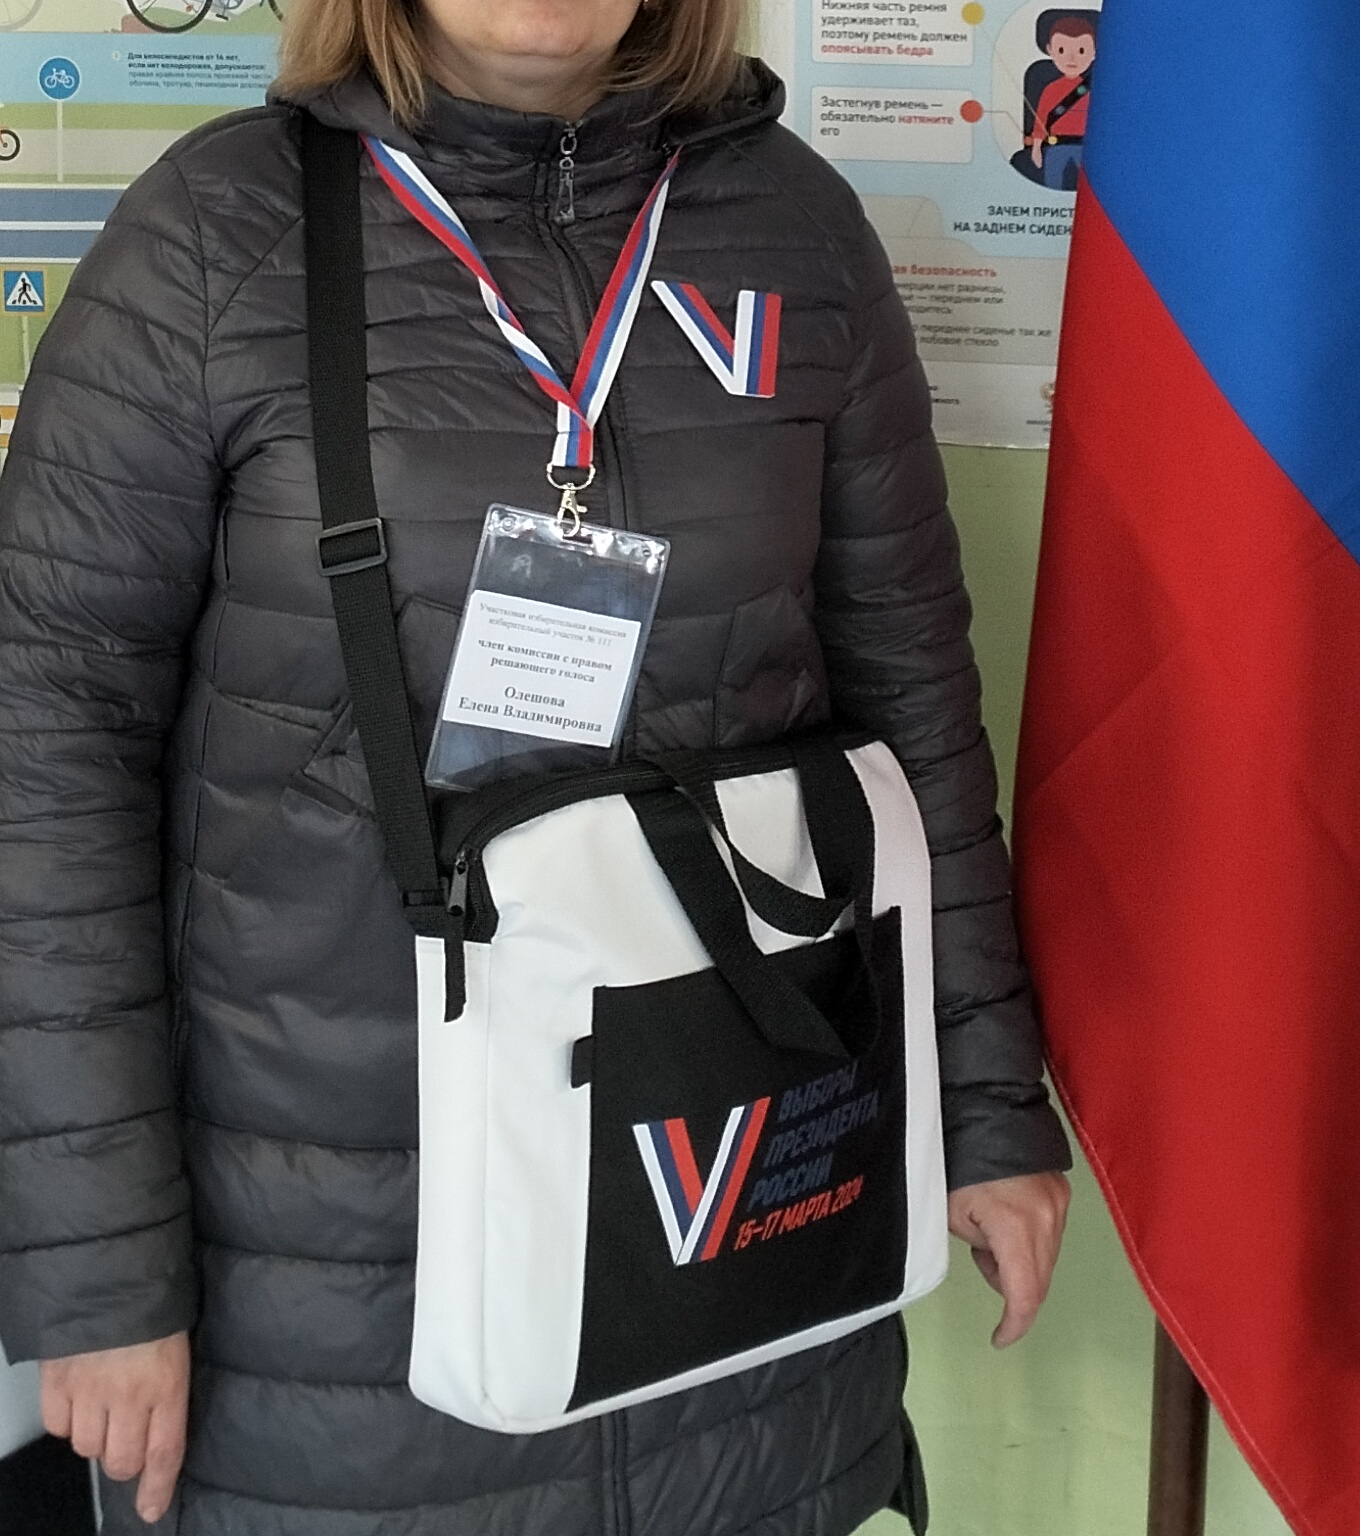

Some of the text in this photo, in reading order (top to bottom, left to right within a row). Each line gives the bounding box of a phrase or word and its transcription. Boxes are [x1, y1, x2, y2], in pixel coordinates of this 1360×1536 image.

[821, 0, 947, 13] Нижняя часть ремня
[821, 15, 920, 28] удерживает таз,
[821, 30, 968, 43] поэтому ремень должен
[821, 44, 934, 58] опоясывать бедра
[821, 96, 929, 111] Застегнув ремень
[820, 110, 954, 125] обязательно натяните
[820, 127, 841, 136] его
[988, 206, 1031, 218] ЗАЧЕМ
[954, 222, 971, 233] НА
[973, 222, 1026, 235] ЗАДНЕМ
[910, 265, 997, 277] безопасность
[478, 638, 613, 672] член комиссии с правом
[490, 656, 596, 683] решающего голоса
[504, 685, 566, 708] Олешова
[458, 696, 603, 734] Елена Владимировна
[777, 1060, 858, 1123] ВЫБОРЫ
[763, 1089, 879, 1168] ПРЕЗИДЕНТА
[746, 1151, 834, 1212] РОССИИ
[778, 1190, 833, 1235] МАРТА
